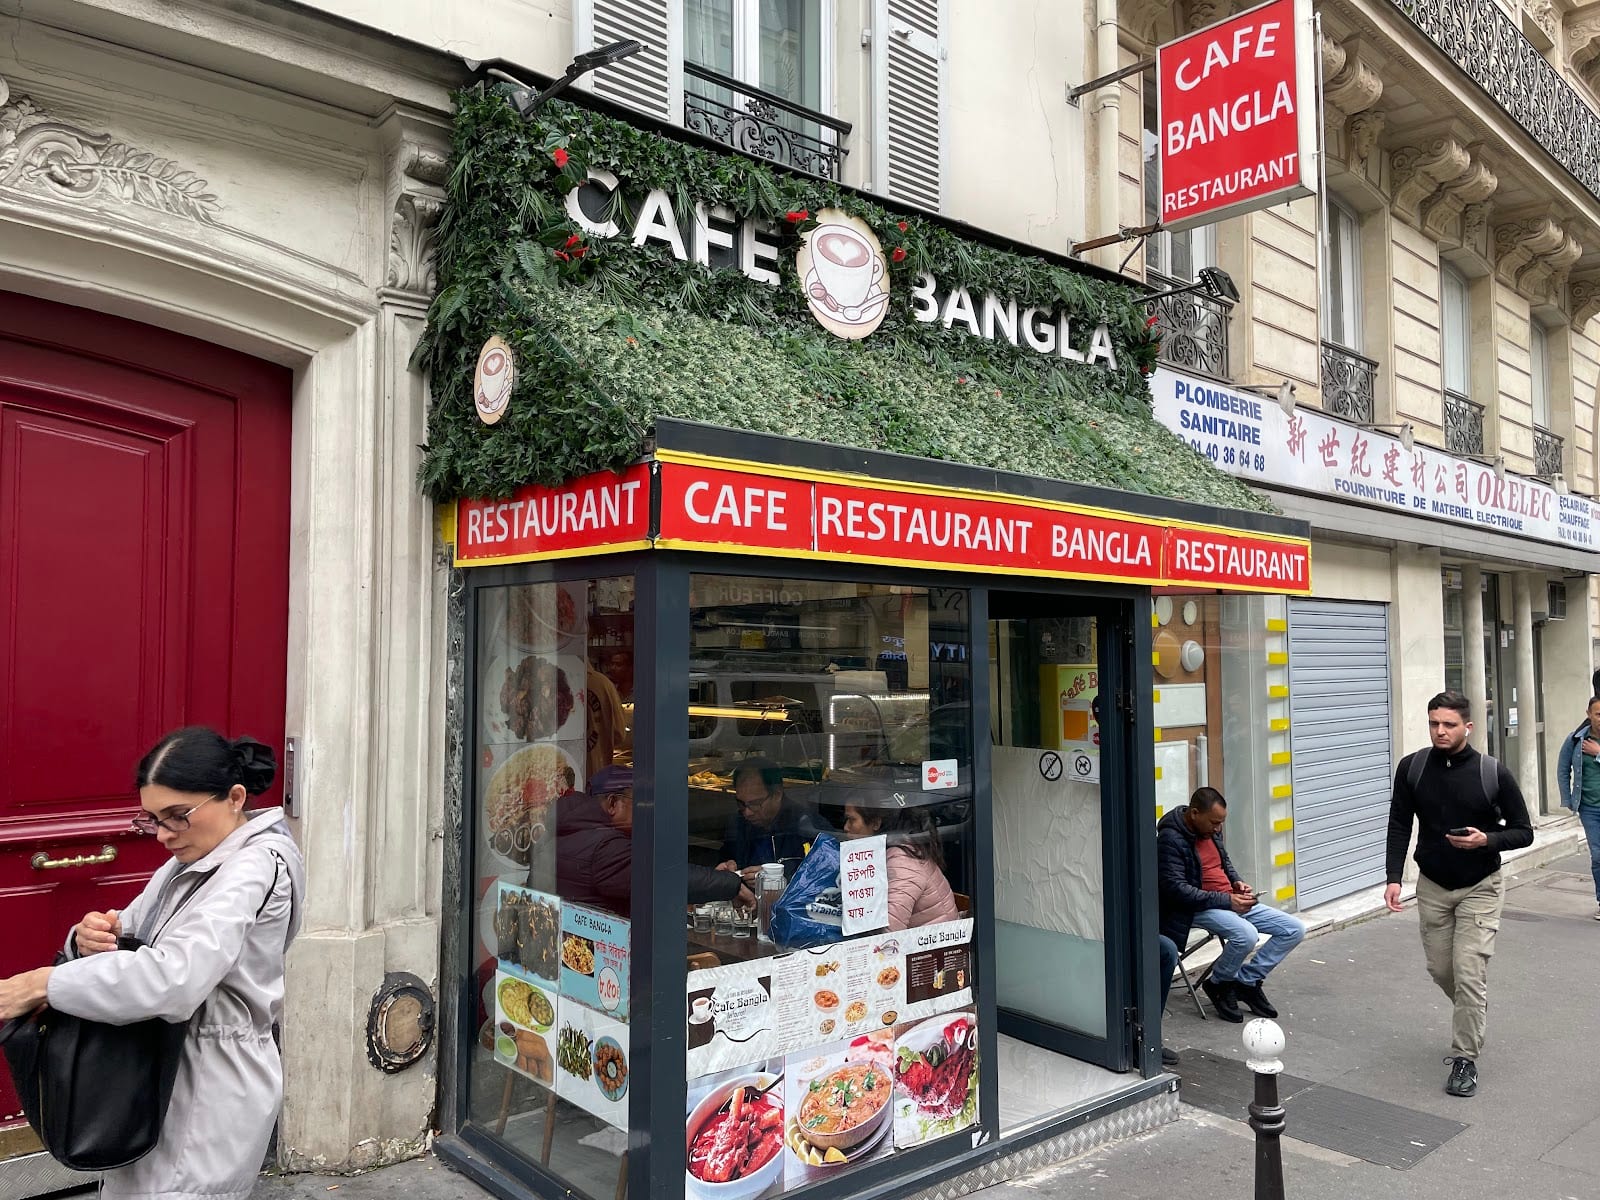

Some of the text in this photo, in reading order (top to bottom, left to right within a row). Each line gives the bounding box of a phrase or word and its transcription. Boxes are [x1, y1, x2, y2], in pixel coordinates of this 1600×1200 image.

[1174, 21, 1281, 92] CAFE
[1166, 80, 1294, 156] BANGLA
[1163, 153, 1297, 213] RESTAURANT
[564, 169, 1118, 370] CAFE BANGLA
[1175, 380, 1262, 421] PLOMBERIE
[1180, 409, 1260, 446] SANITAIRE
[1206, 442, 1218, 462] 40
[1223, 446, 1235, 465] 36
[1239, 449, 1250, 468] 64
[1254, 453, 1265, 472] 68
[467, 480, 640, 546] RESTAURANT
[1334, 478, 1523, 531] FOURNITURE DE MATERIEL ELECTRIQUE
[1477, 471, 1552, 522] ORELEC
[684, 480, 1306, 582] CAFE RESTAURANT BANGLA RESTAURANT
[1559, 512, 1590, 530] CHAUFFAGE
[847, 865, 876, 882] চটপটি
[574, 913, 612, 934] CAFE BANGLA
[917, 929, 967, 946] Cafe Bangla
[714, 999, 736, 1013] Cafe
[737, 993, 768, 1008] Bangla
